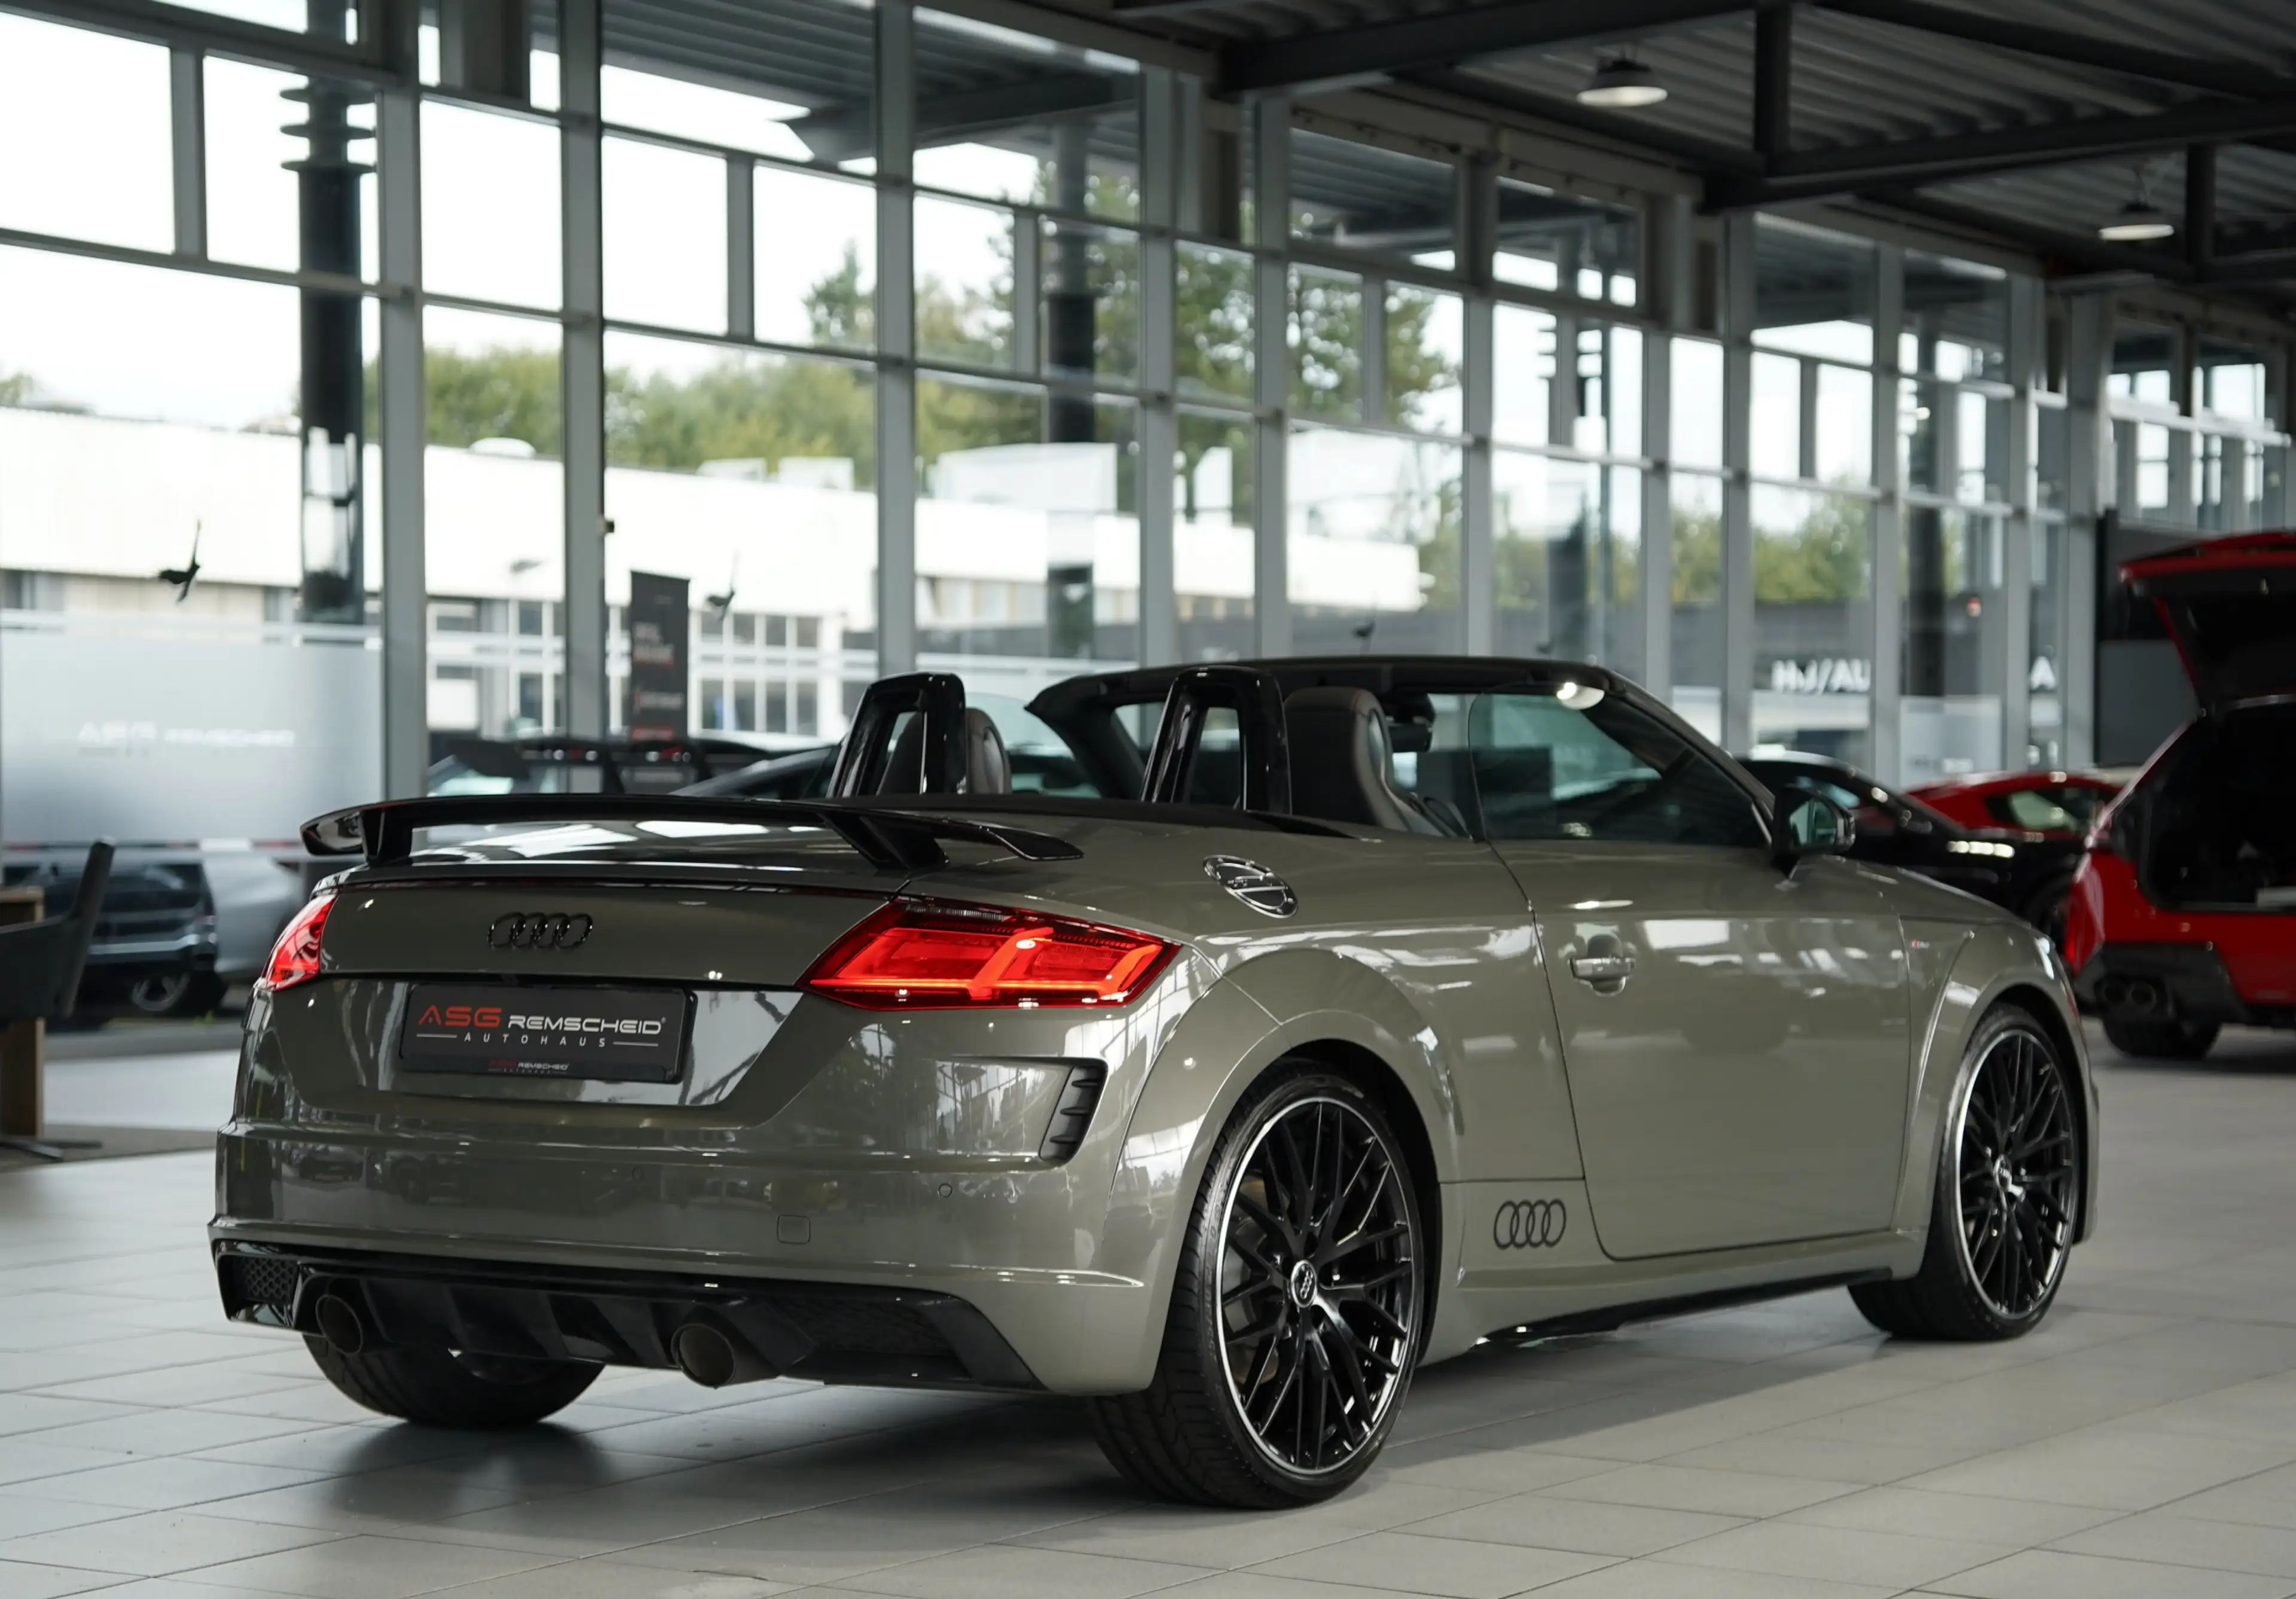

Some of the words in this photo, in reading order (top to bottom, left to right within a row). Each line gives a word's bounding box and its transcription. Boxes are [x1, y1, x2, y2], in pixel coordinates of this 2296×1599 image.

[419, 1005, 502, 1028] ASG
[508, 1015, 661, 1035] REMSCHEID
[464, 1032, 605, 1047] AUTOHAUS
